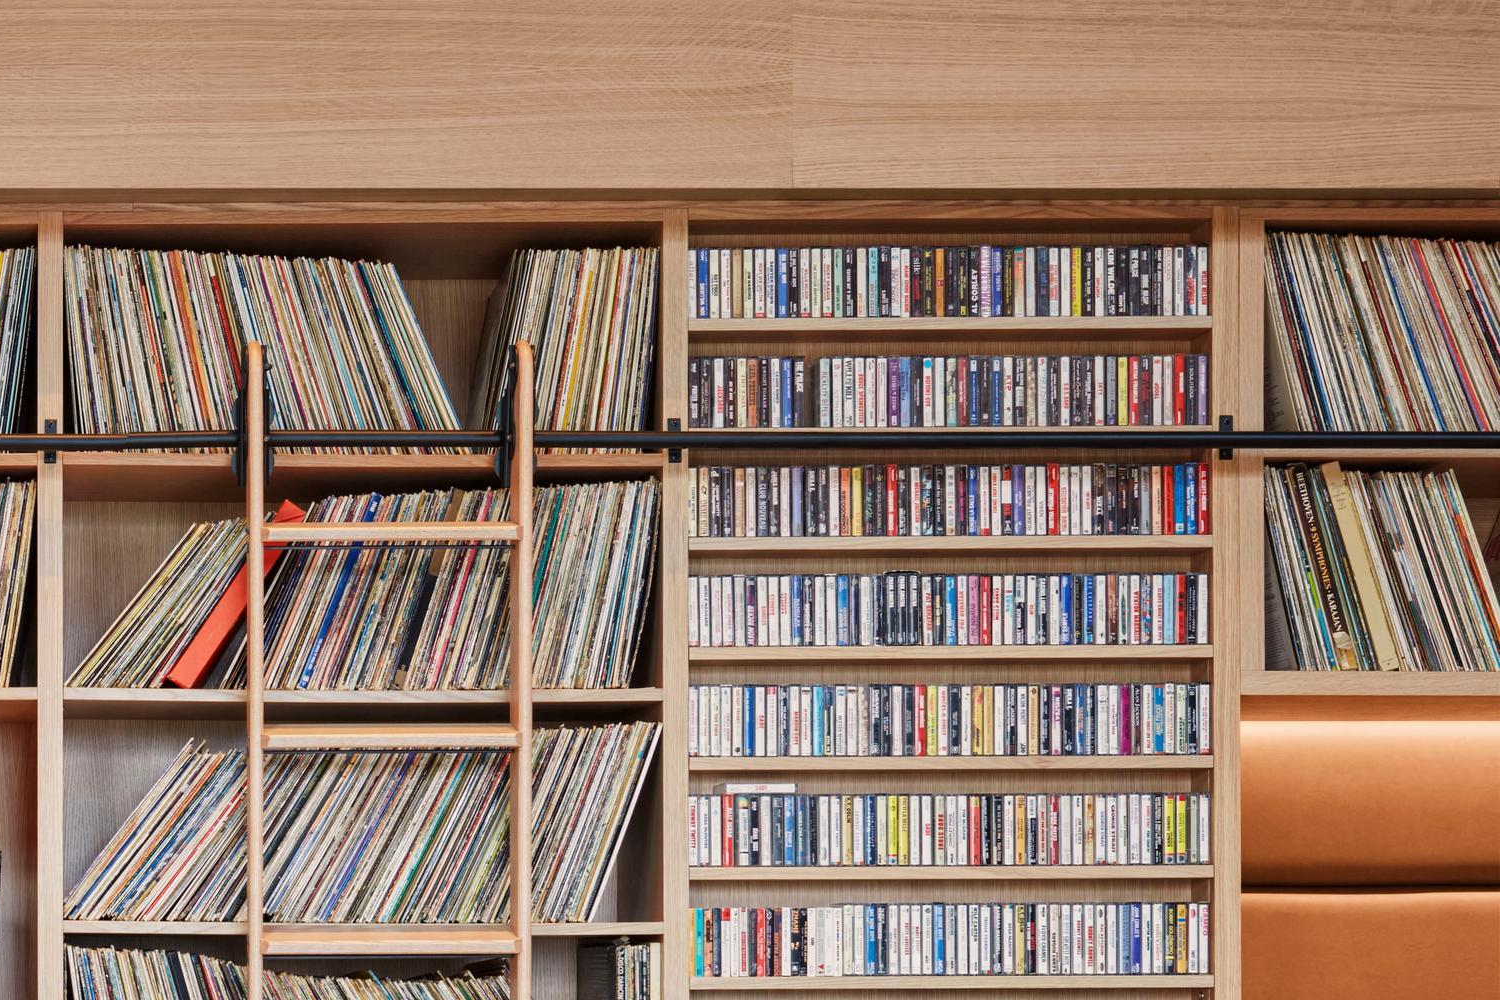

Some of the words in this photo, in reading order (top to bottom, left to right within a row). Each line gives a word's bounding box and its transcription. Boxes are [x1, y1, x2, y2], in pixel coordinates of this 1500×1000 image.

[971, 303, 978, 313] AL
[1296, 472, 1315, 524] BEETHOVEN
[1311, 533, 1332, 590] SYMPHONIES
[1327, 594, 1342, 632] KARAJAN
